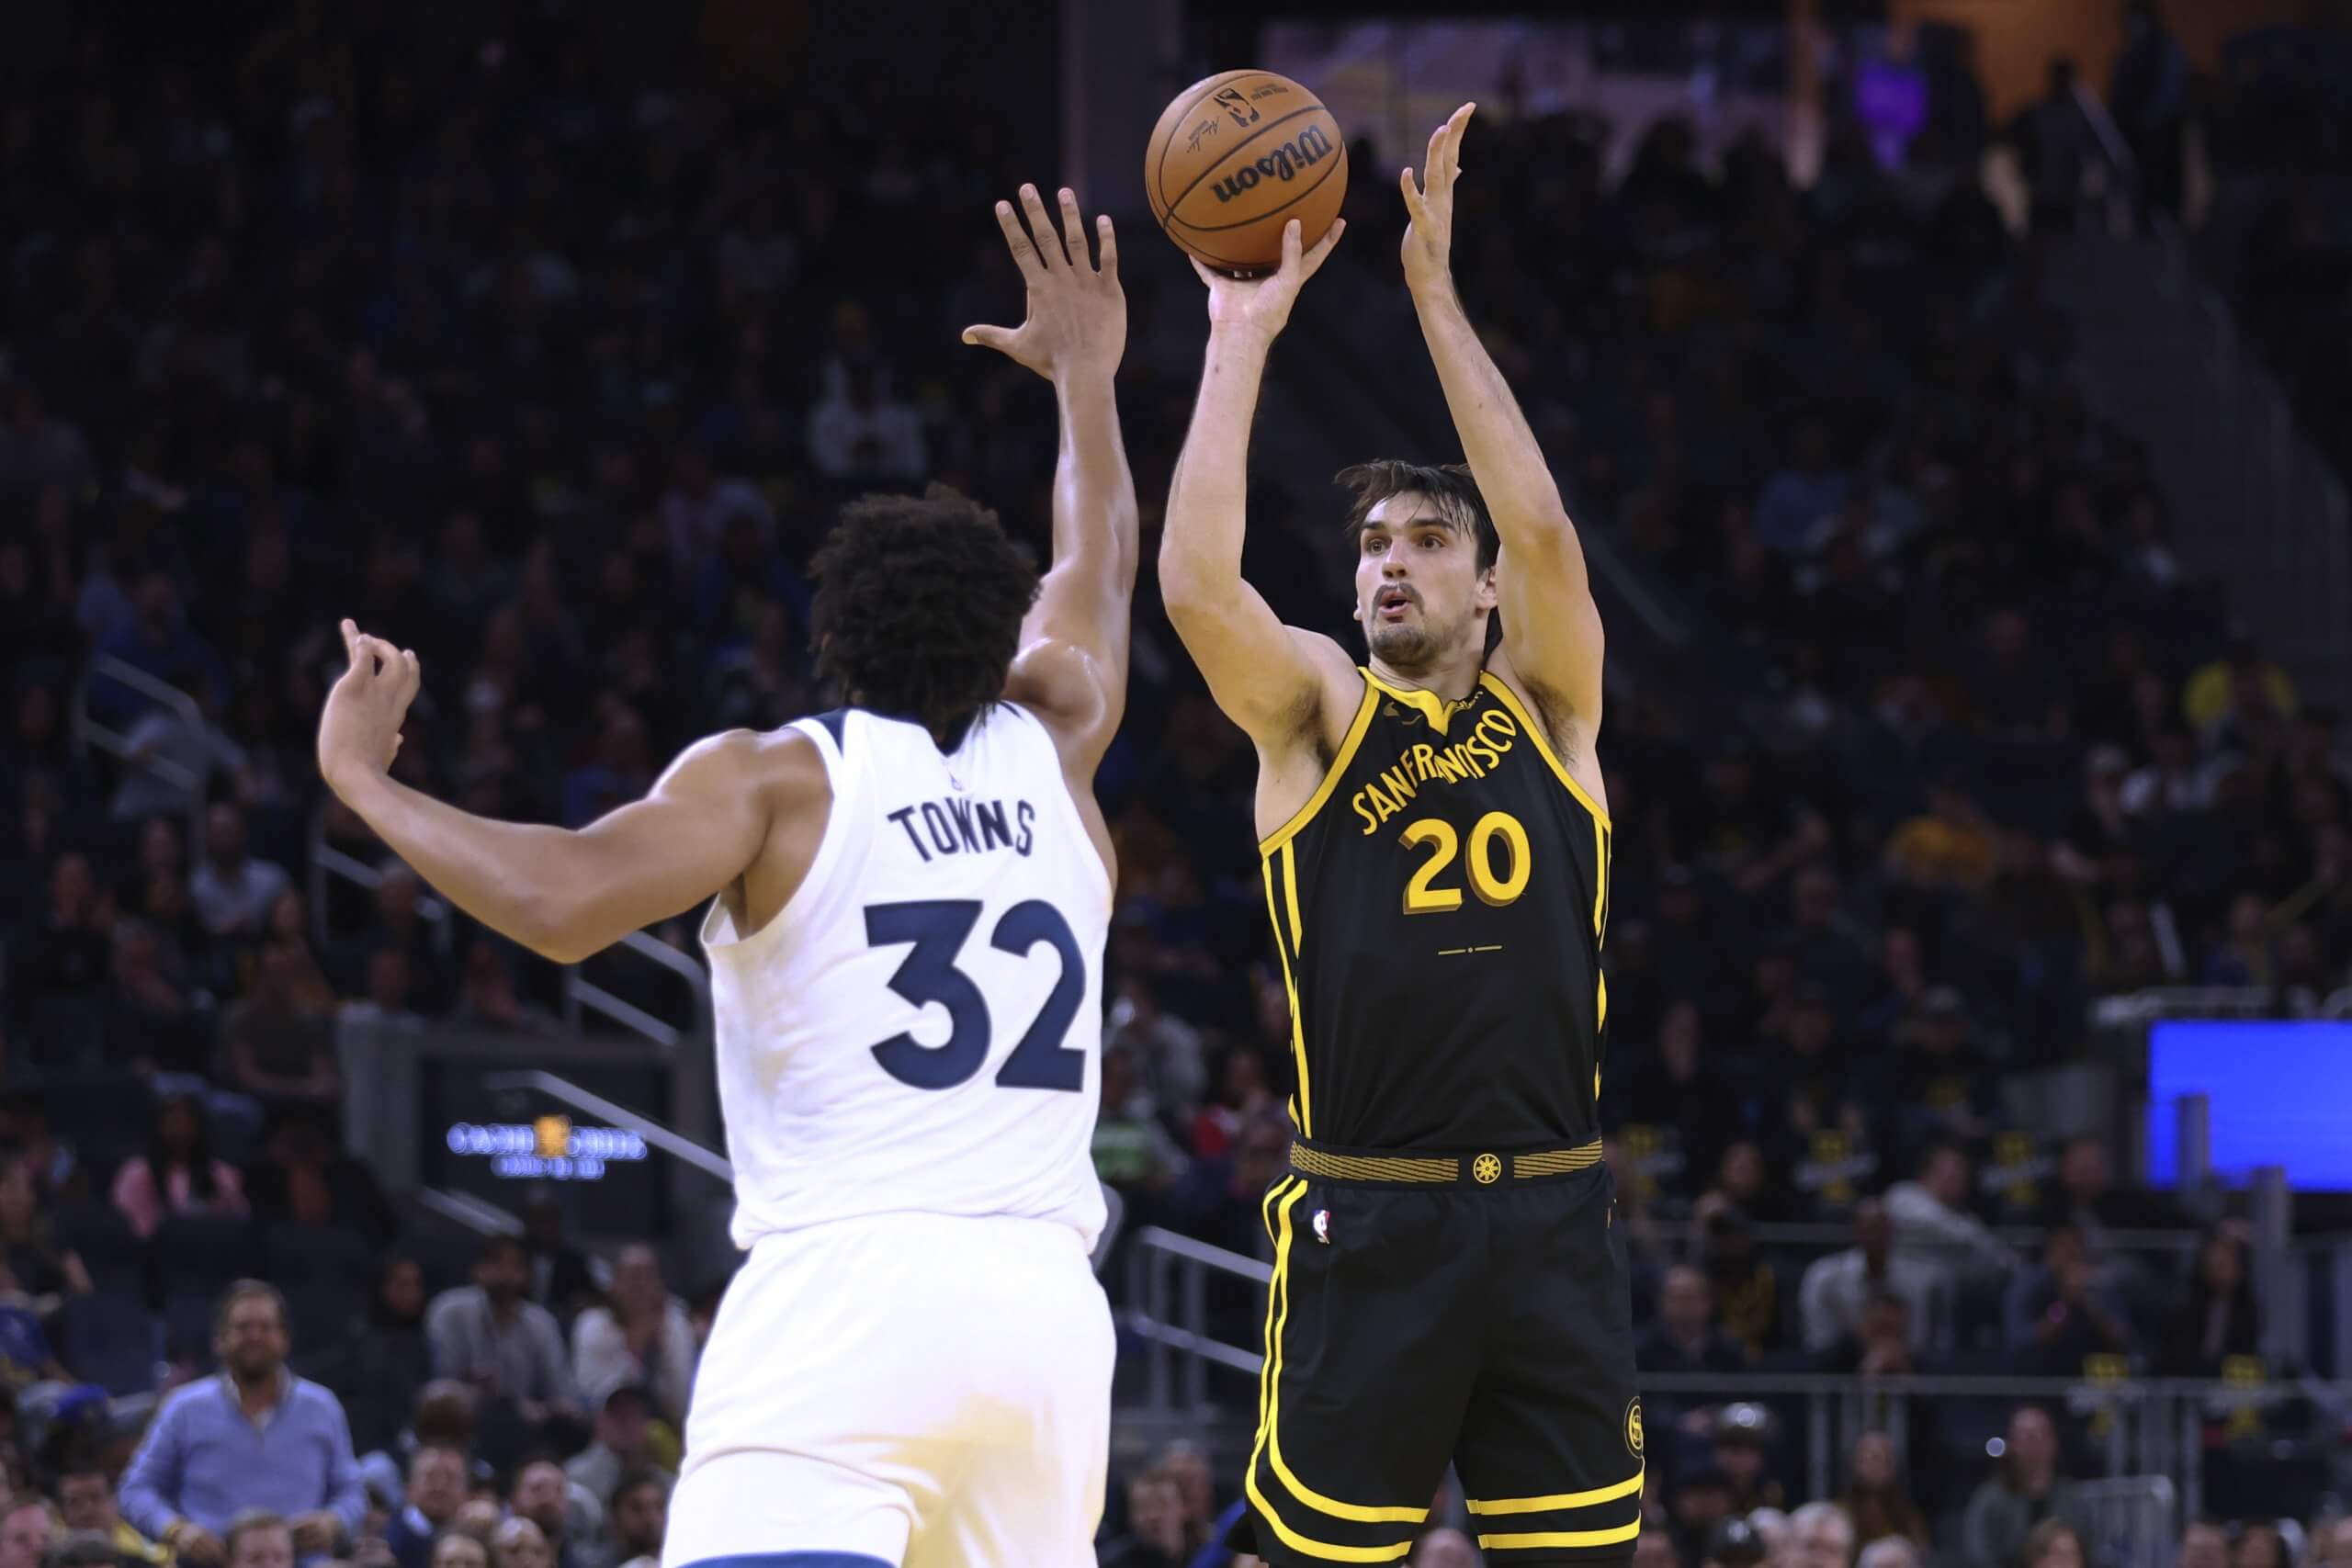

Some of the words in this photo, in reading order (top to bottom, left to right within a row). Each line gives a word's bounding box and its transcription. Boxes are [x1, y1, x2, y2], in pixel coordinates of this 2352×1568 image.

[1210, 124, 1333, 203] Wilson
[1351, 765, 1417, 836] SAN
[1399, 708, 1517, 789] FRNISCO
[887, 796, 1035, 863] TOWNS
[1398, 810, 1532, 915] 20
[863, 898, 1087, 1093] 32
